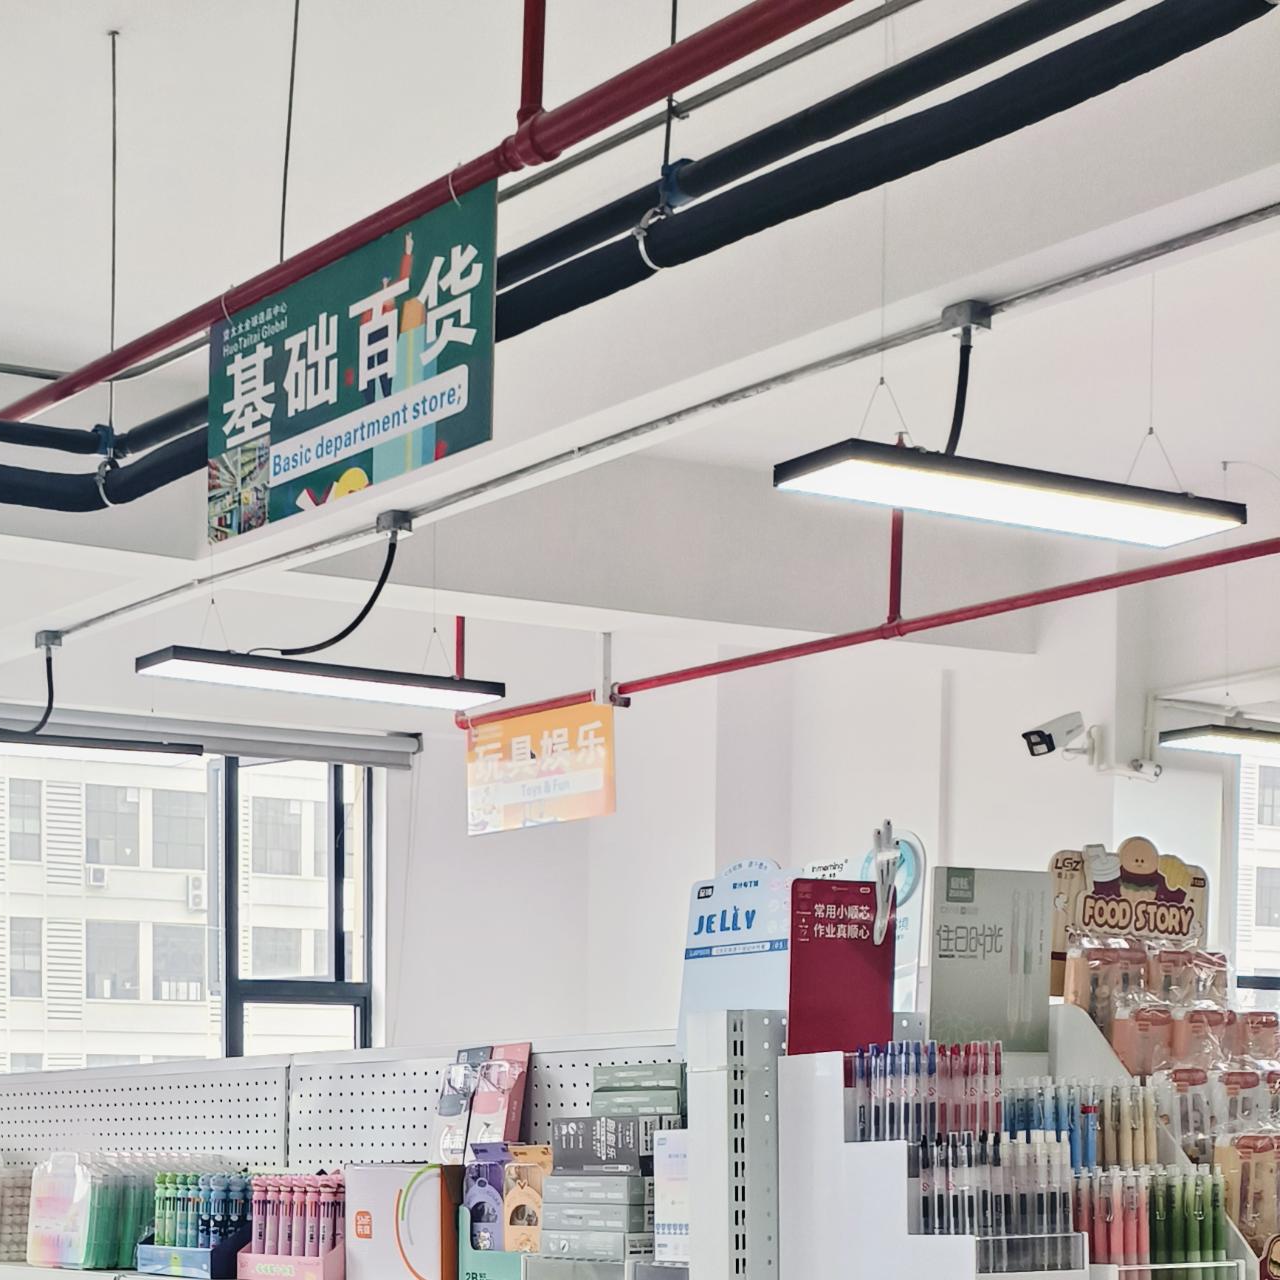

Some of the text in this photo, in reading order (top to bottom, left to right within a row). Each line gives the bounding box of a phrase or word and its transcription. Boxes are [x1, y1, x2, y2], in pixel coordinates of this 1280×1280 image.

[221, 244, 483, 449] 基础百货
[273, 443, 312, 477] Basic
[315, 405, 409, 459] department
[1055, 858, 1083, 871] LGZ
[694, 906, 756, 936] JELLY
[814, 903, 871, 920] 常用小顺芯
[1083, 896, 1194, 936] FOOD STORY
[814, 922, 871, 940] 作业真顺心
